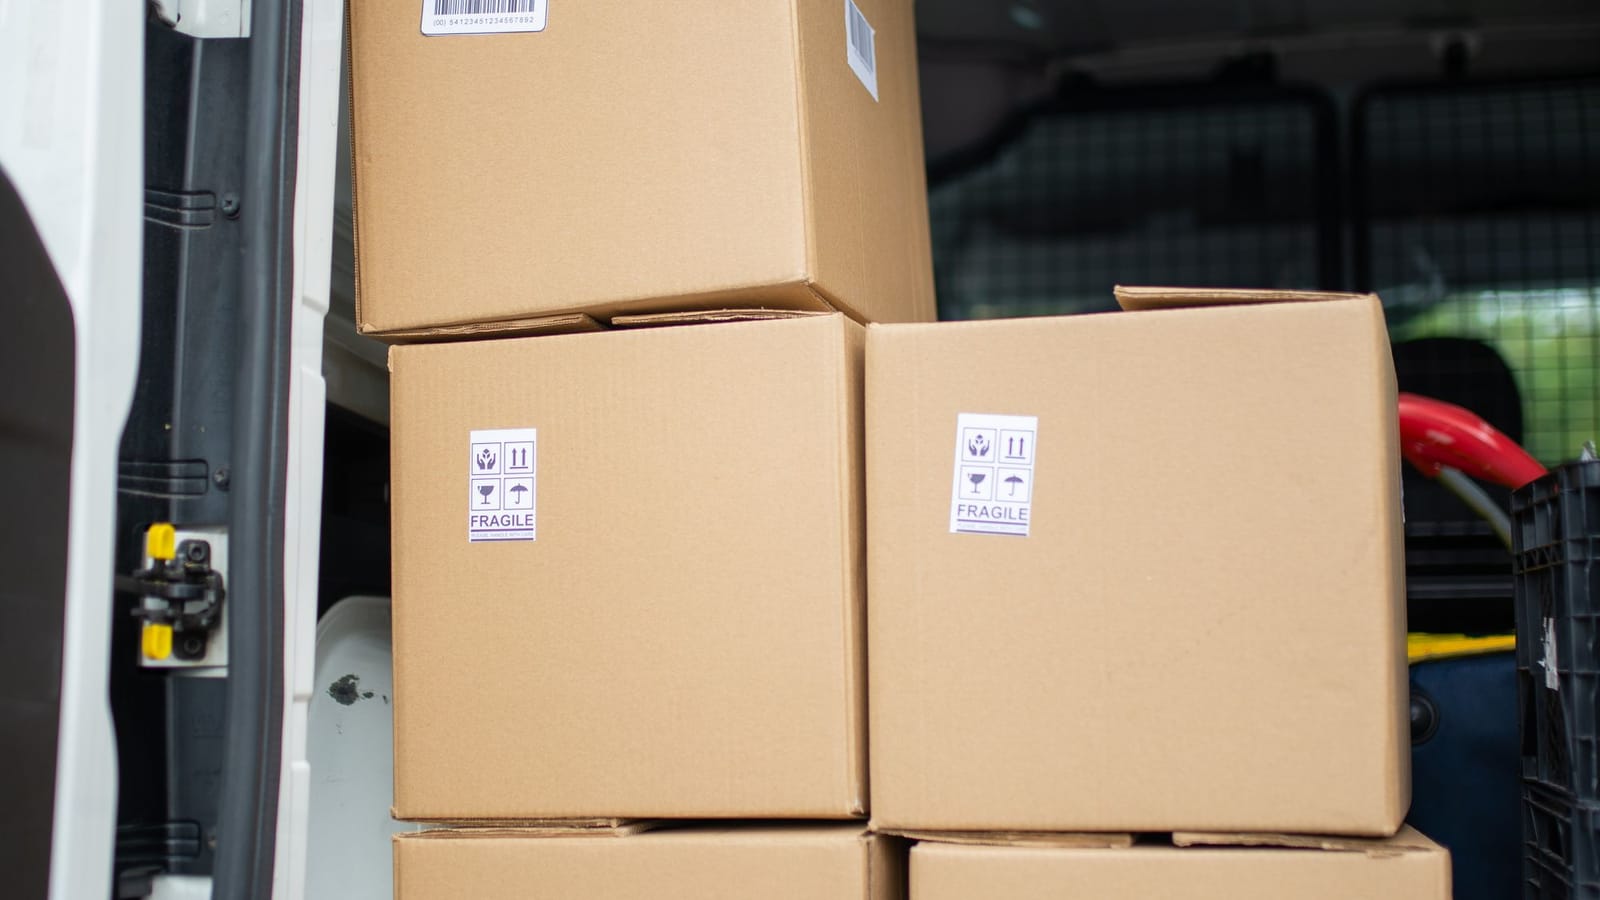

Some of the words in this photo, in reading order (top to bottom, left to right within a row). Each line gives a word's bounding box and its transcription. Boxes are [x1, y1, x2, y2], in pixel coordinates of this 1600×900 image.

[433, 19, 447, 27] (00)
[957, 504, 1029, 521] FRAGILE
[471, 514, 534, 527] FRAGILE
